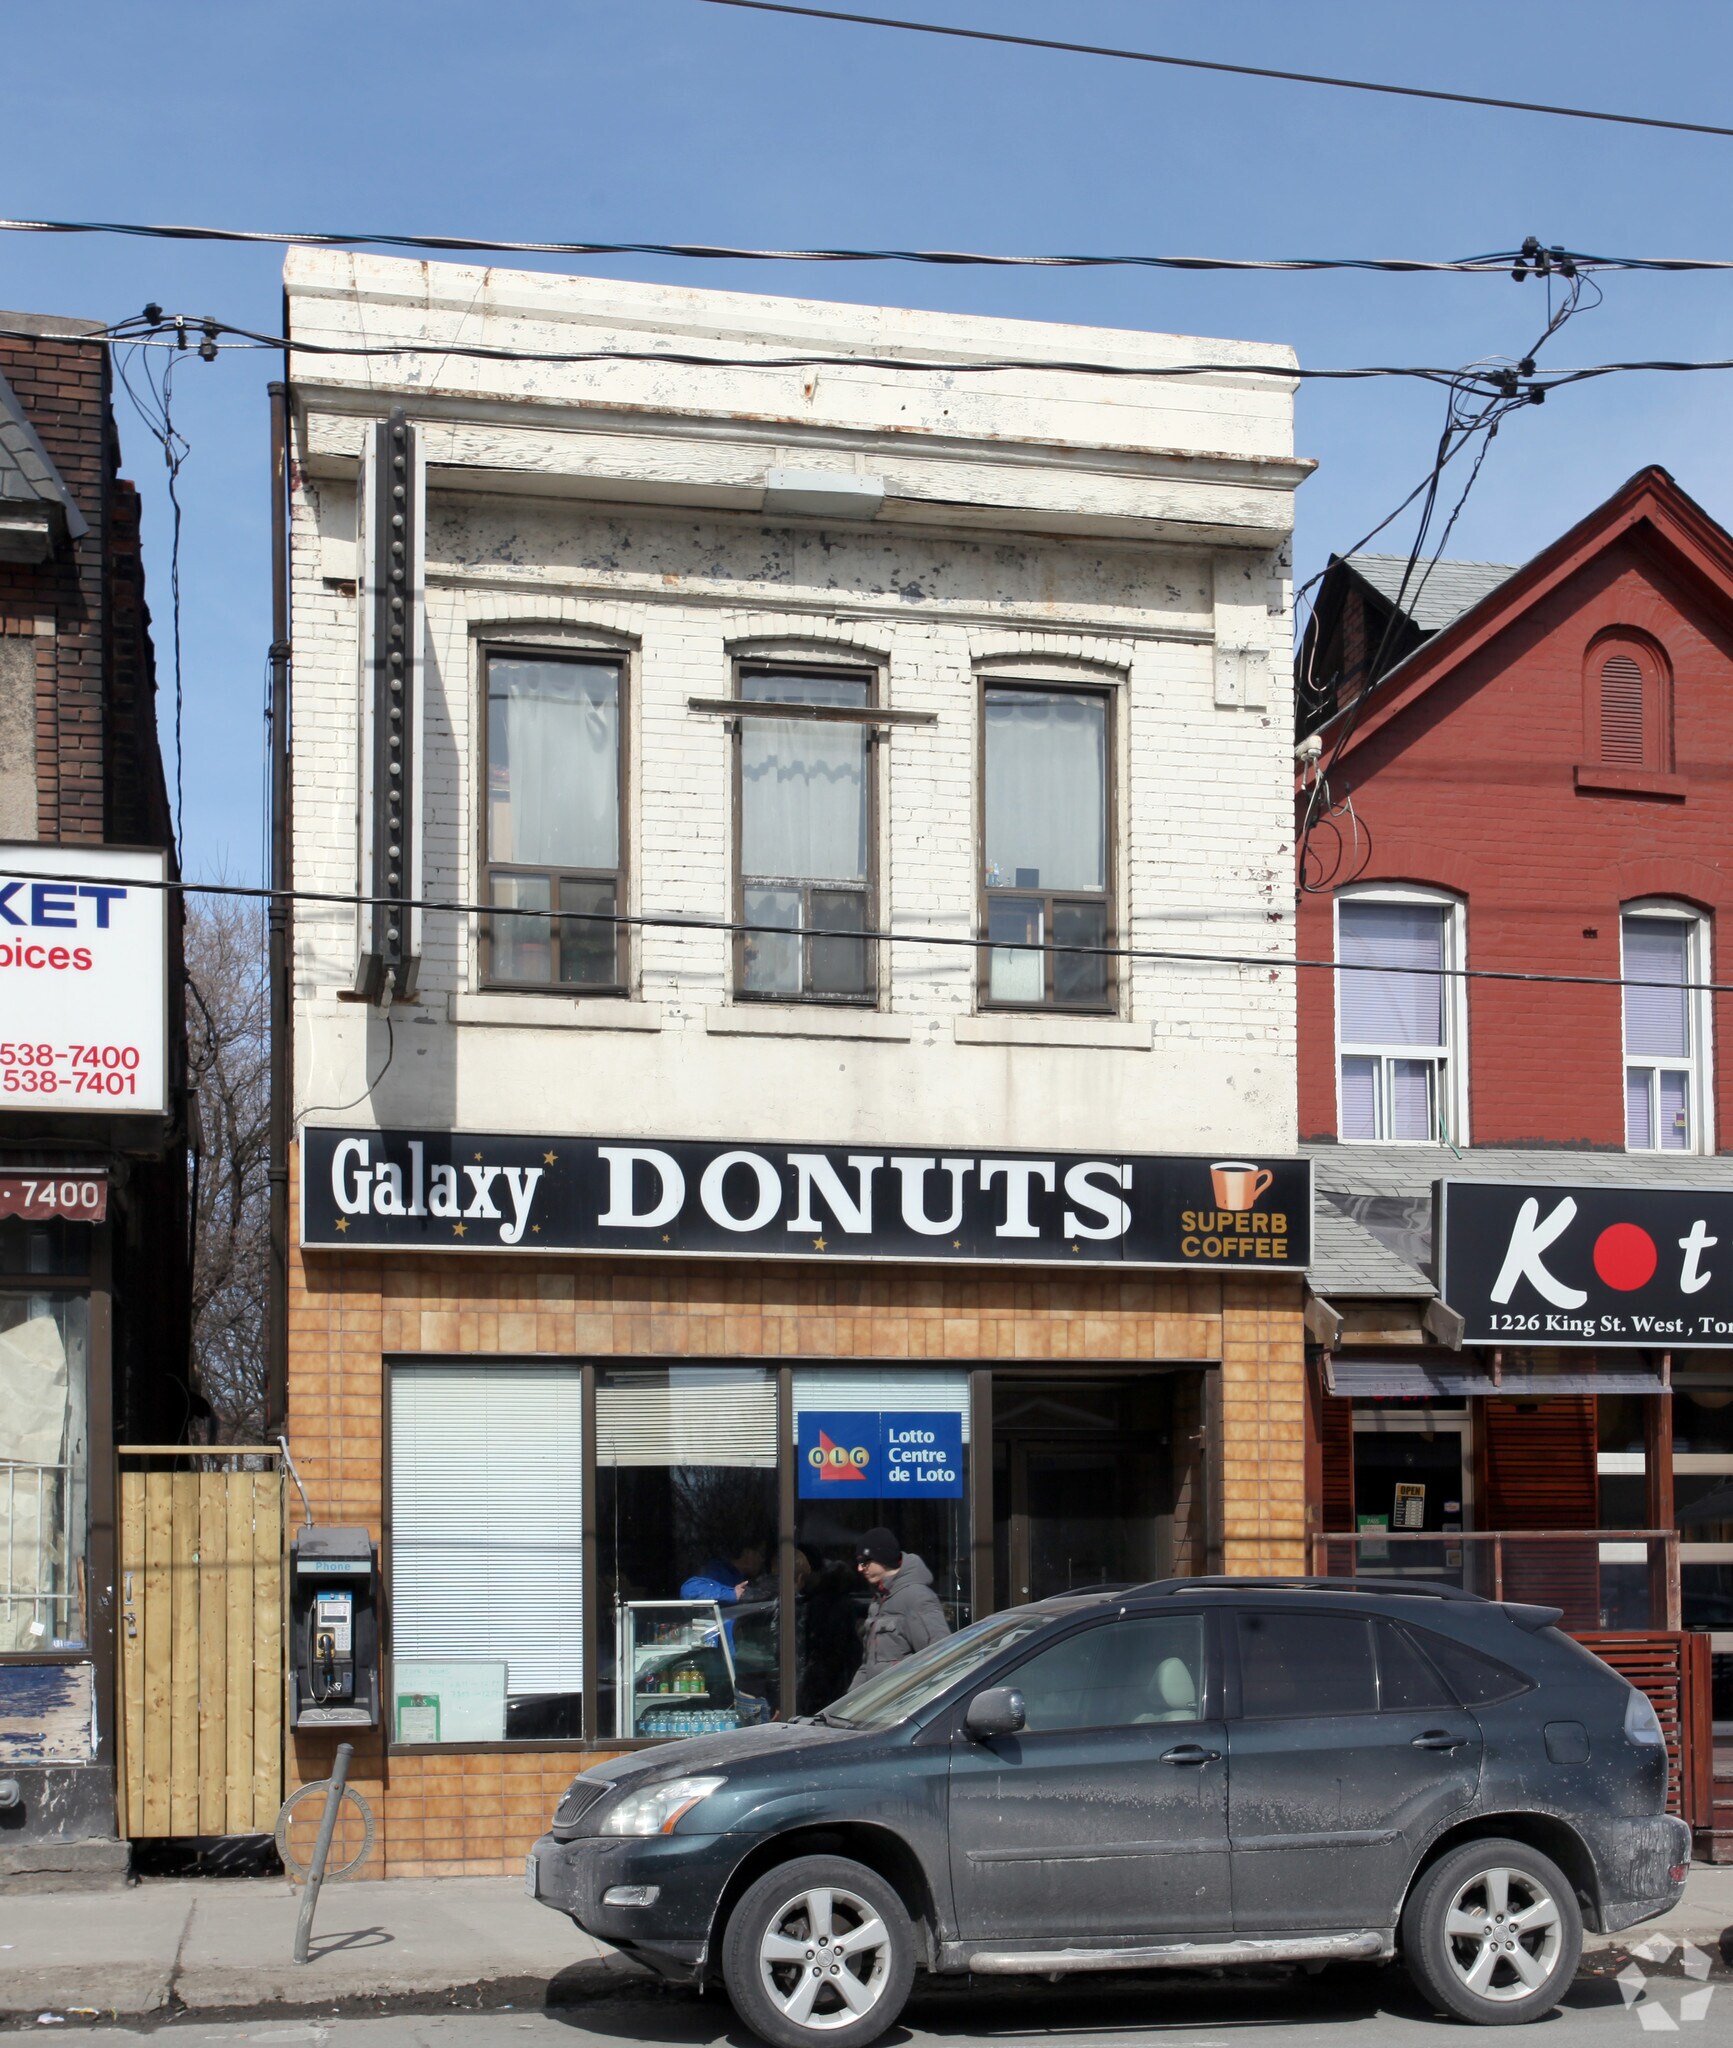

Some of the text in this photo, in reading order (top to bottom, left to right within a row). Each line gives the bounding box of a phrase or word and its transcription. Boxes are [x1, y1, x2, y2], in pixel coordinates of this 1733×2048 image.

[0, 1043, 140, 1070] 538-7400
[3, 1069, 135, 1096] 538-7401
[21, 1181, 99, 1208] 7400
[331, 1137, 1133, 1244] Galaxy DONUTS
[1181, 1210, 1288, 1234] SUPERB
[1181, 1236, 1288, 1258] COFFEE
[1489, 1314, 1540, 1331] 1226
[1545, 1314, 1596, 1337] King
[1600, 1315, 1627, 1333] St.
[889, 1428, 935, 1444] Lotto
[811, 1448, 866, 1466] OLG
[888, 1447, 947, 1463] Centre
[888, 1466, 956, 1482] de Loto
[1401, 1486, 1420, 1495] OPEN
[315, 1561, 351, 1571] Phone
